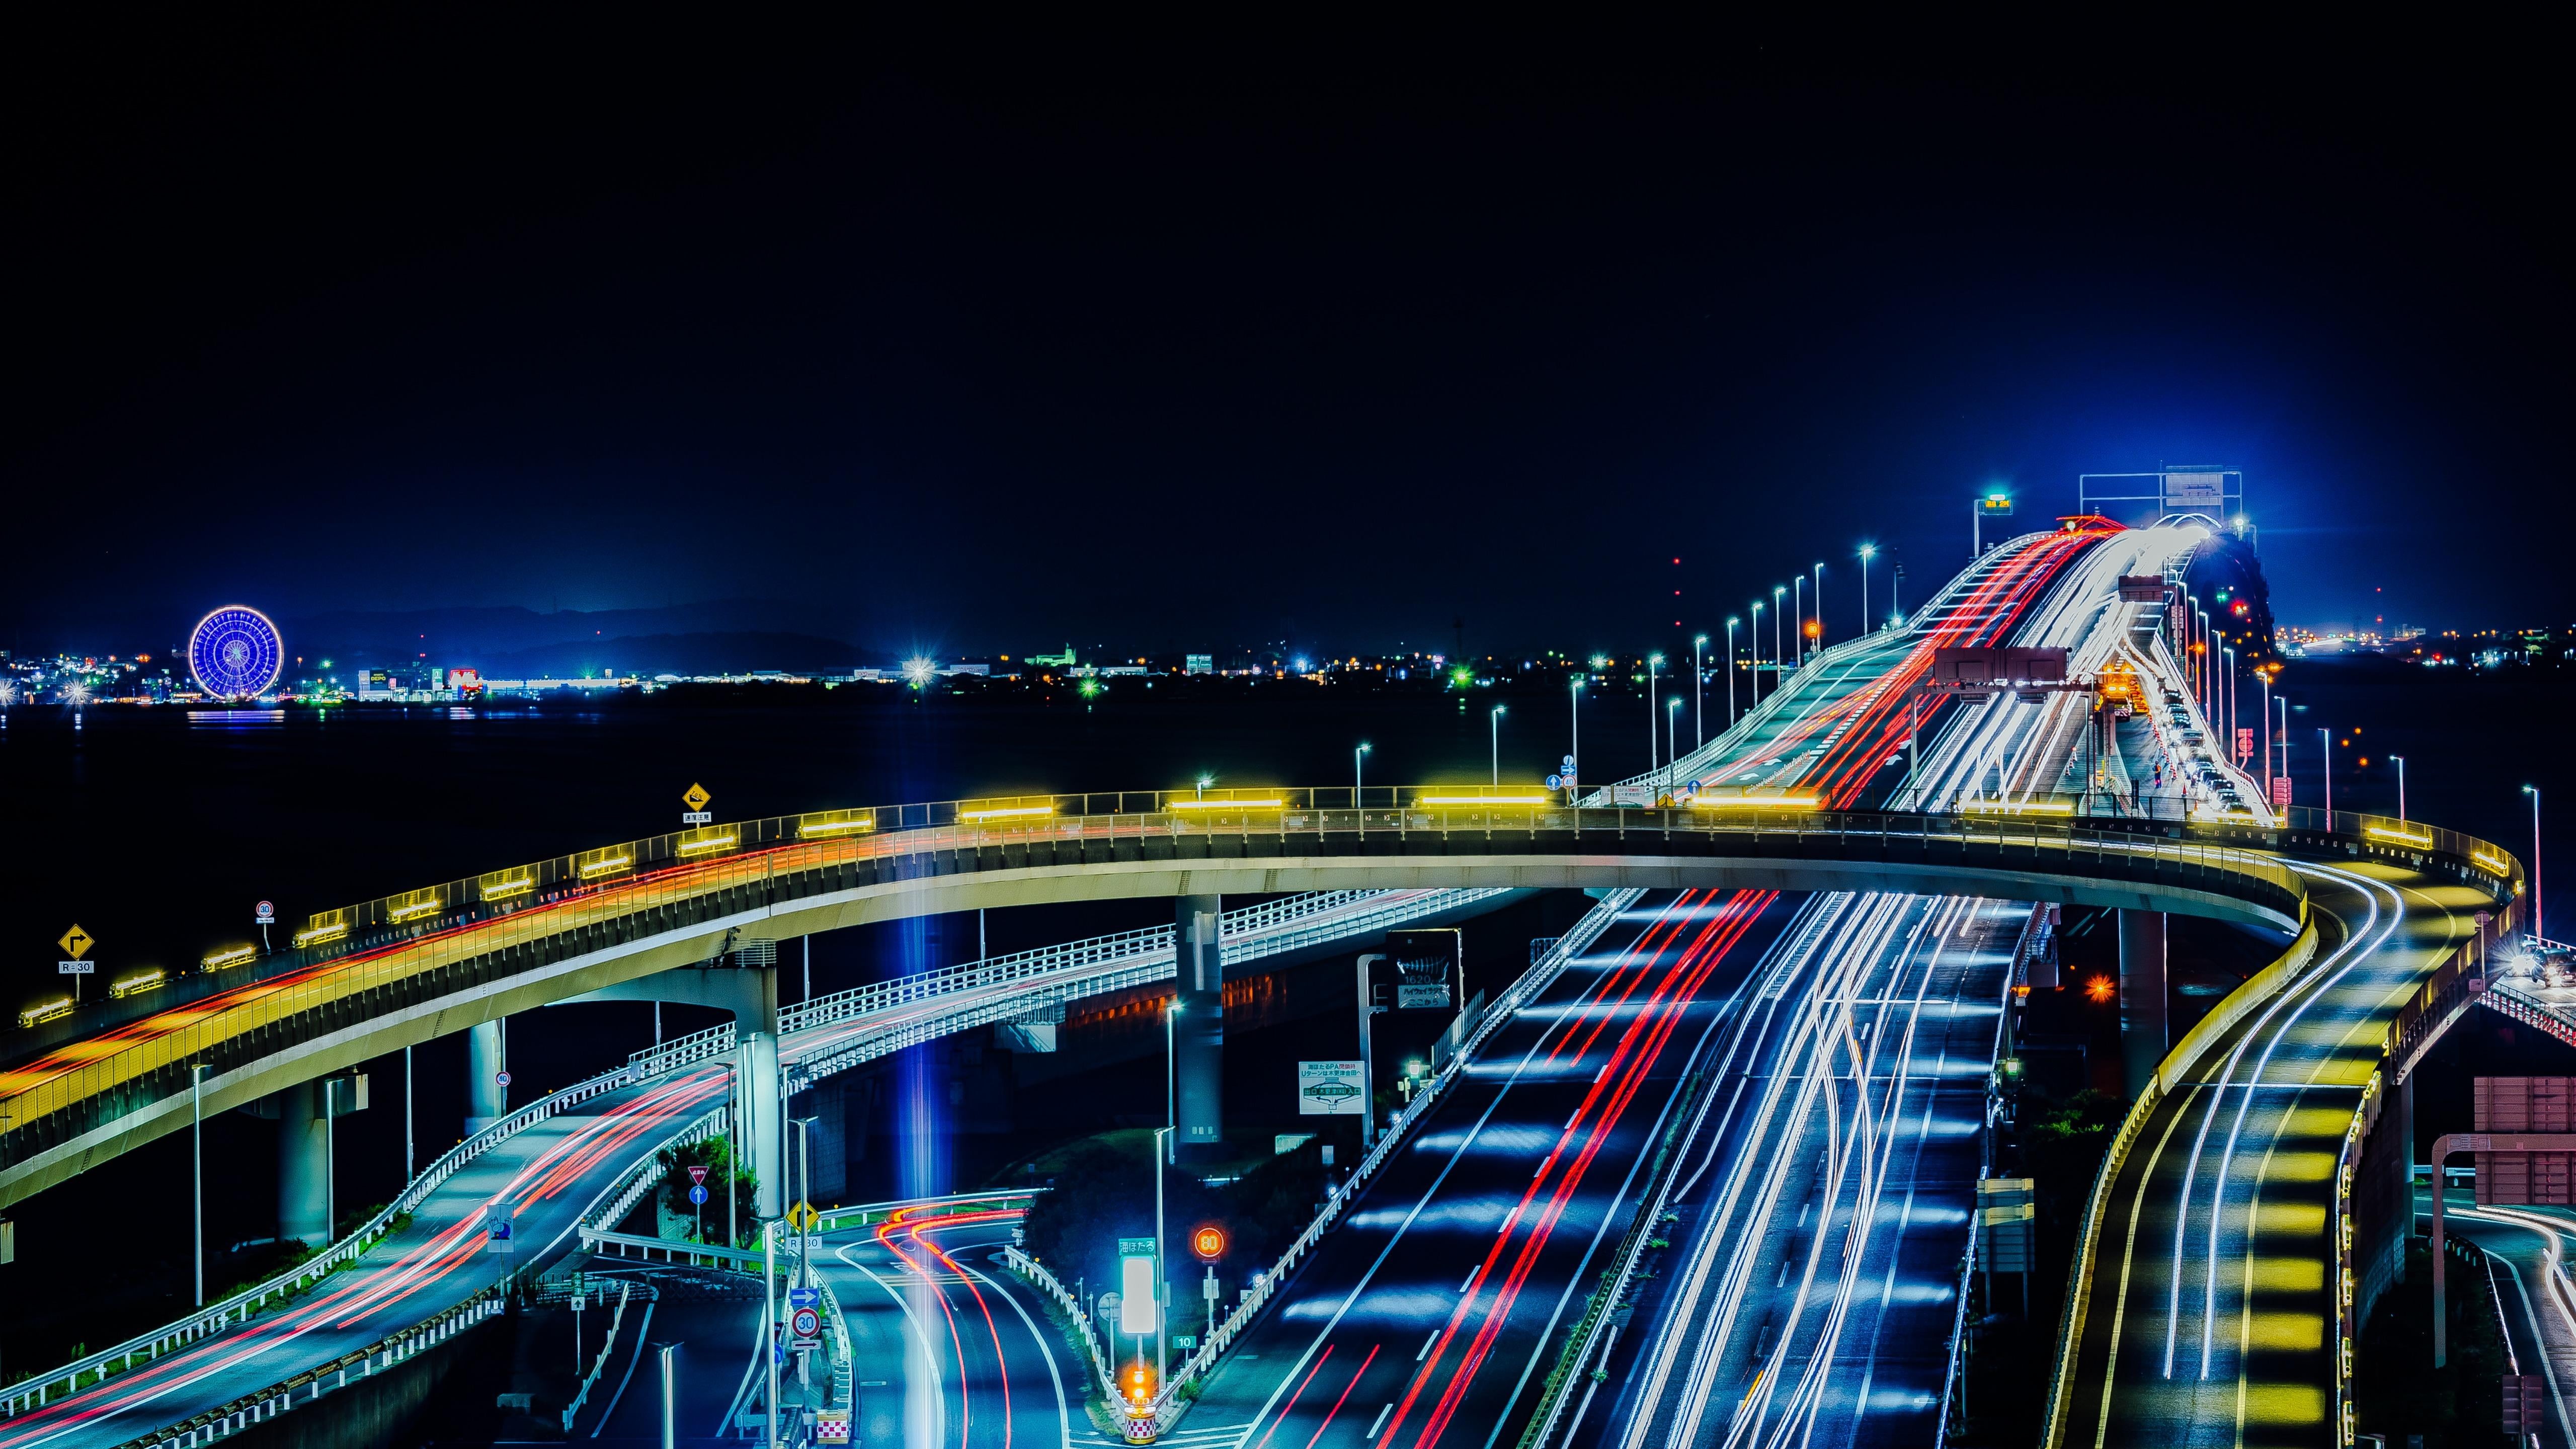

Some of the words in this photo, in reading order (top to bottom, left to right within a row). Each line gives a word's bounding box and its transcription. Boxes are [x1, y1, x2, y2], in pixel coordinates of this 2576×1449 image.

[1405, 975, 1430, 984] 1620
[1408, 998, 1439, 1006] ここから
[1119, 1241, 1154, 1253] 海ほたる
[1200, 1236, 1218, 1251] 80
[798, 1316, 814, 1330] 30
[1178, 1337, 1191, 1347] 10
